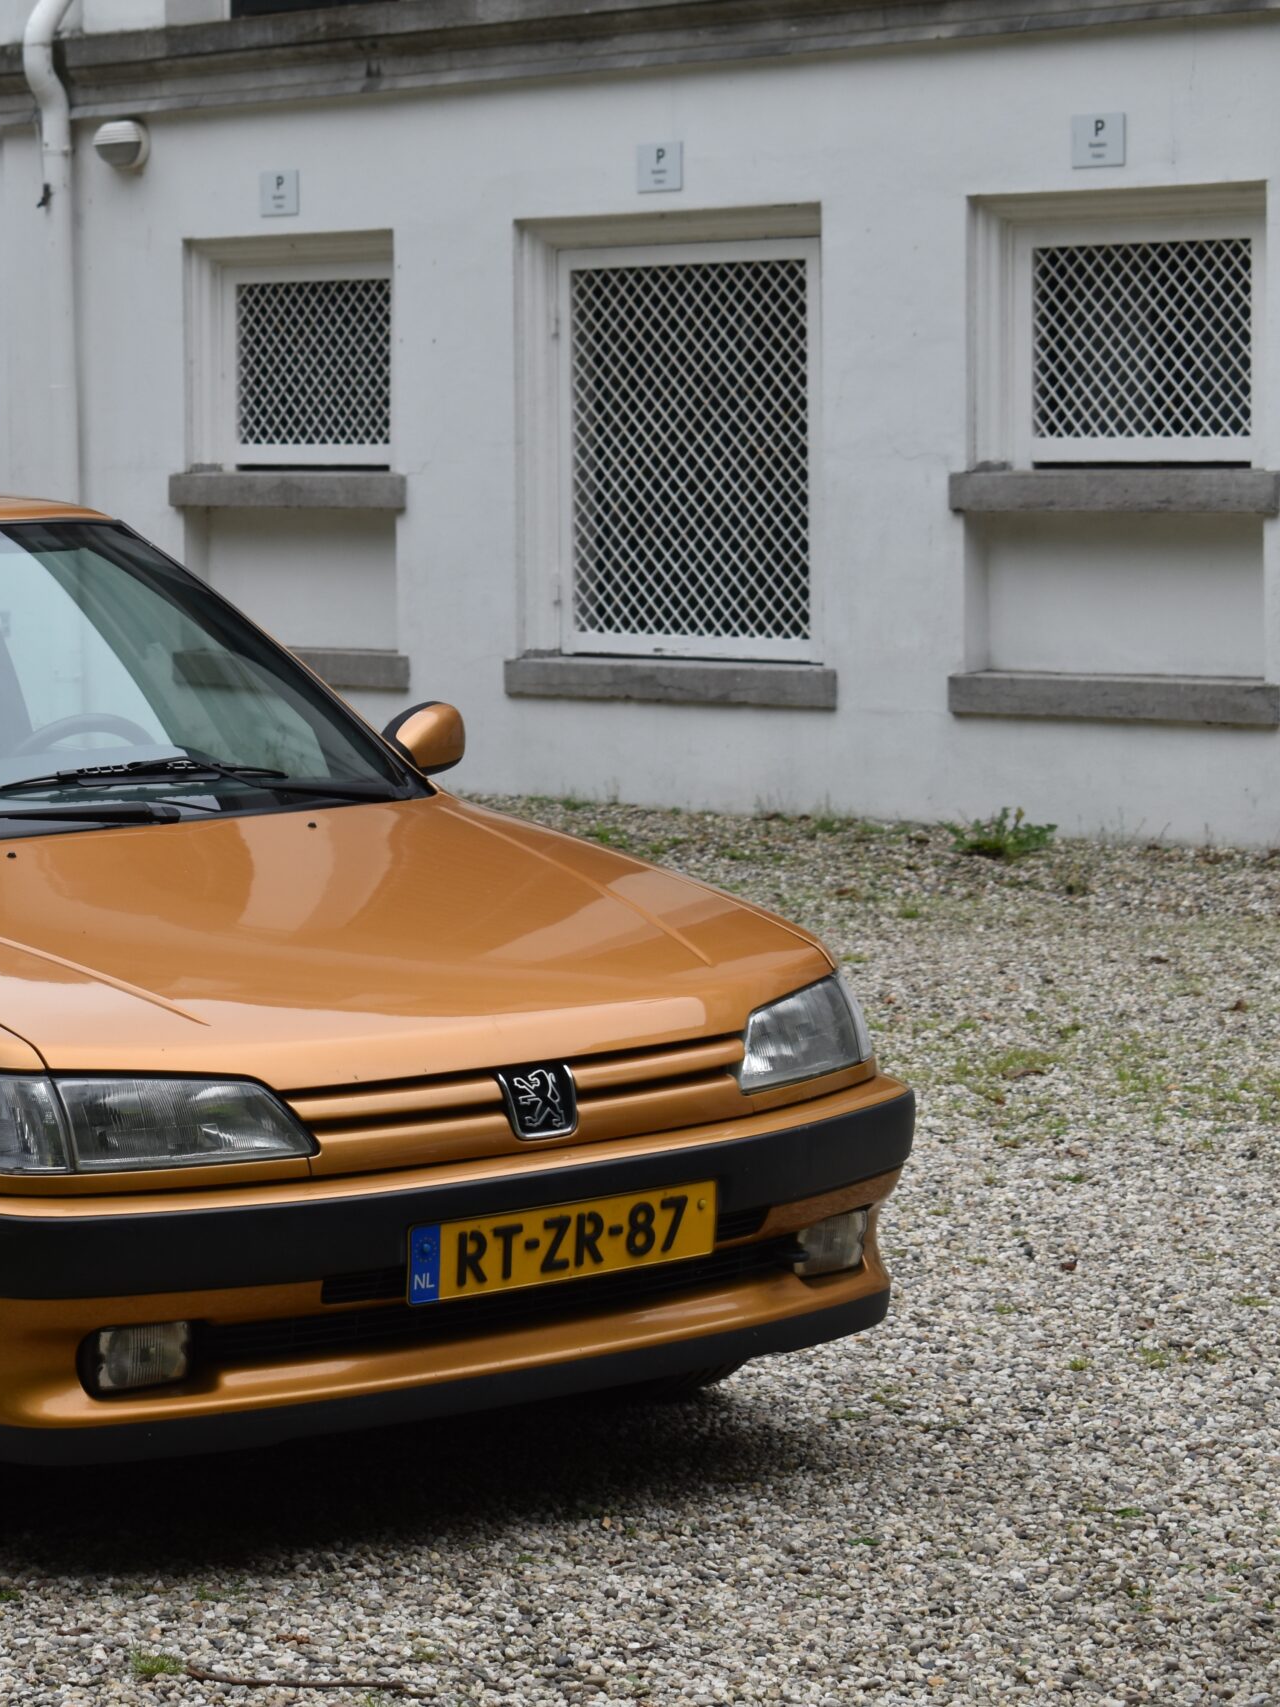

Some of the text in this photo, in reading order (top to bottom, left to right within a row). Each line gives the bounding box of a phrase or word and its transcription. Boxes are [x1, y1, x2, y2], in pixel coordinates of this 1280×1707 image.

[1094, 119, 1105, 137] P
[656, 148, 665, 164] P
[276, 175, 284, 190] P
[456, 1195, 688, 1288] RT-ZR-87
[413, 1273, 435, 1290] NL
